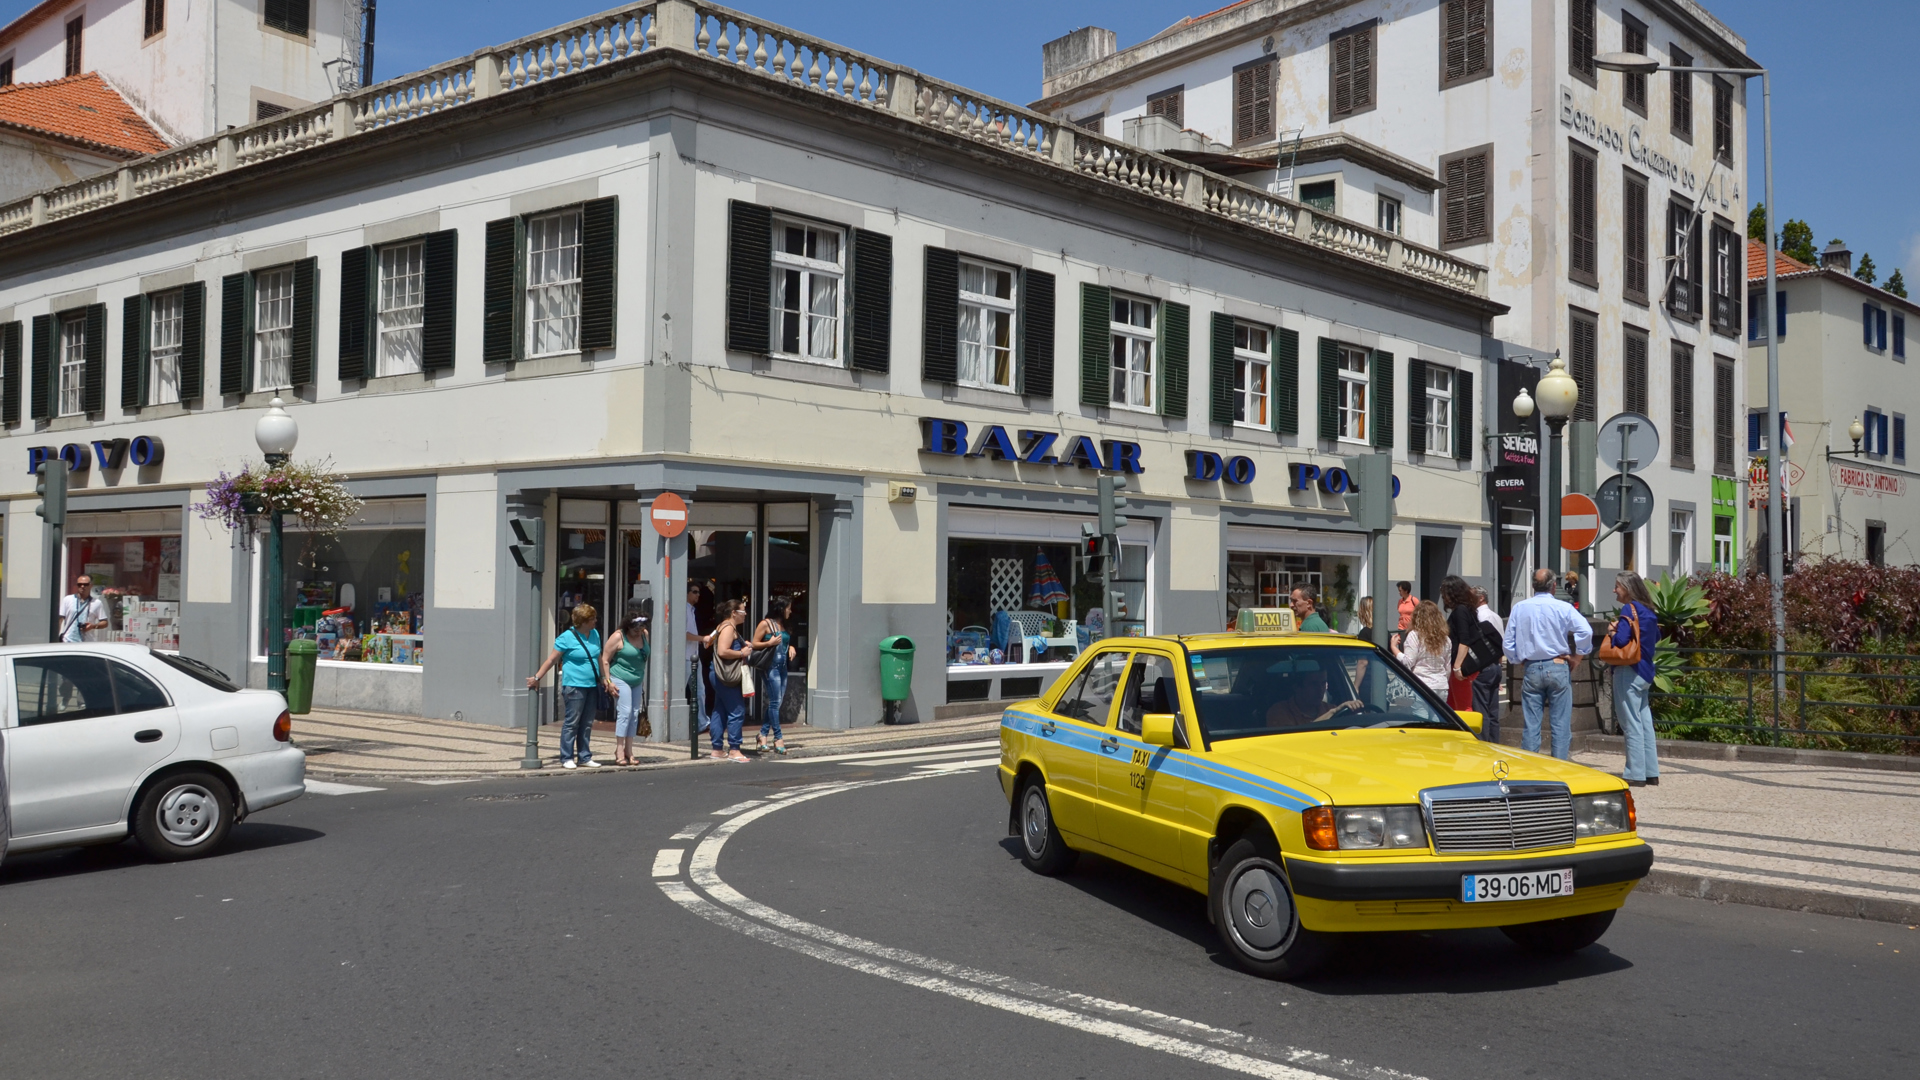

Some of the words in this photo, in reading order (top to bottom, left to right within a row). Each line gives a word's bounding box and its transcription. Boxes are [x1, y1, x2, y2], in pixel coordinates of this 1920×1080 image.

[1628, 124, 1678, 183] CRUZEIRO
[1682, 167, 1695, 191] DO
[1502, 435, 1539, 455] SEVERA
[27, 436, 165, 474] POVO
[918, 416, 1145, 474] BAZAR
[1184, 449, 1256, 485] DO
[1288, 462, 1401, 499] PO
[1495, 479, 1525, 487] SEVERA
[1874, 474, 1898, 493] ANTONIO
[1255, 613, 1280, 626] TAXI
[1132, 749, 1151, 767] TAXI
[1130, 771, 1146, 790] 1129
